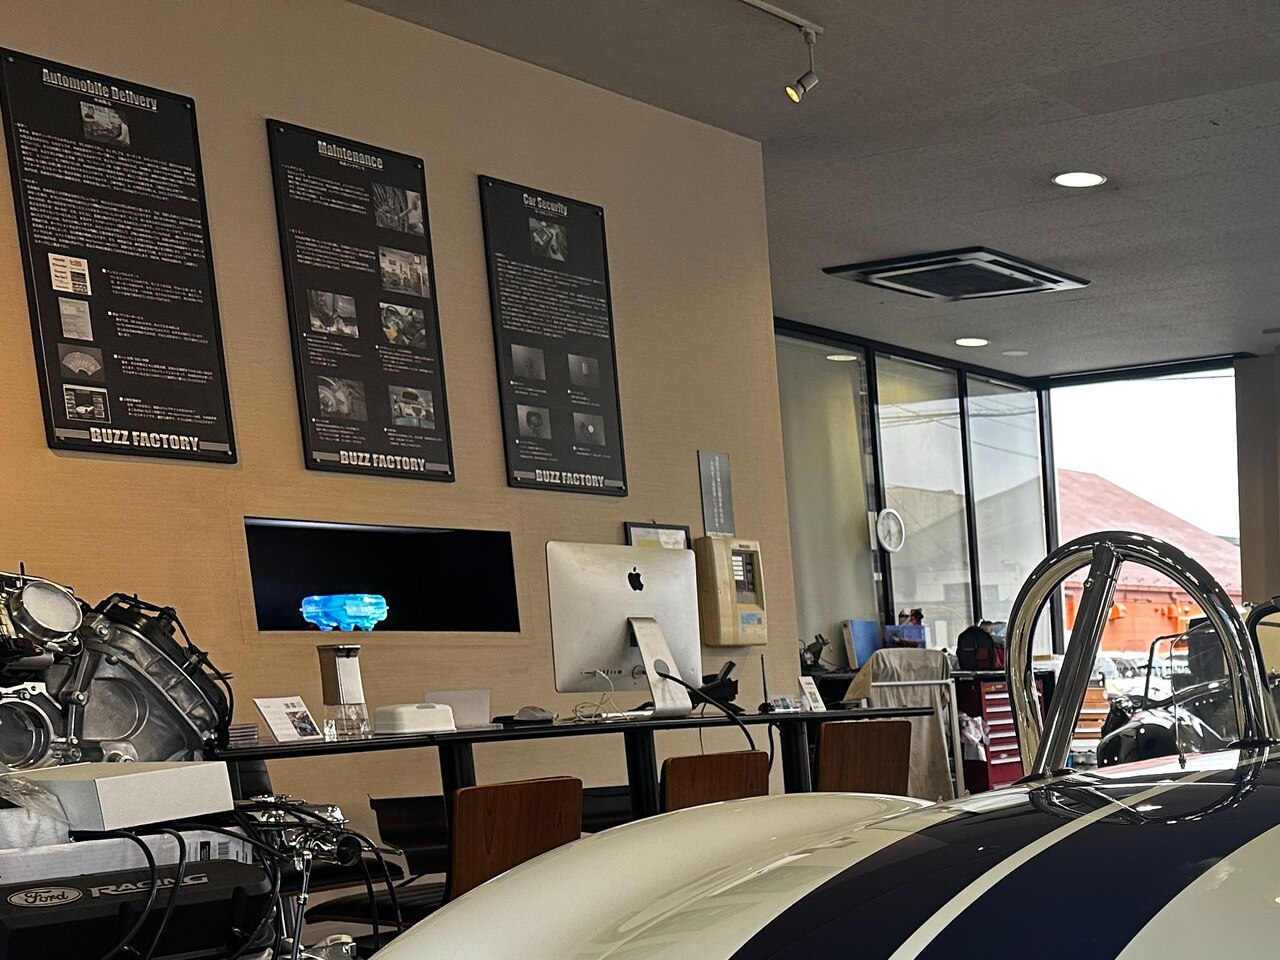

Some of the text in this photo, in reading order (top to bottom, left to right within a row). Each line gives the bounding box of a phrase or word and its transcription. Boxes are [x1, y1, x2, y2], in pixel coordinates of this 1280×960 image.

[43, 68, 158, 110] Automobile Delivery
[318, 141, 384, 169] Maintenance
[523, 193, 536, 206] Car
[537, 197, 568, 215] Security
[90, 427, 200, 451] BUZZ FACTORY
[340, 451, 426, 472] BUZZ FACTORY
[535, 469, 605, 488] BUZZ FACTORY
[24, 873, 209, 904] Ford RACING
